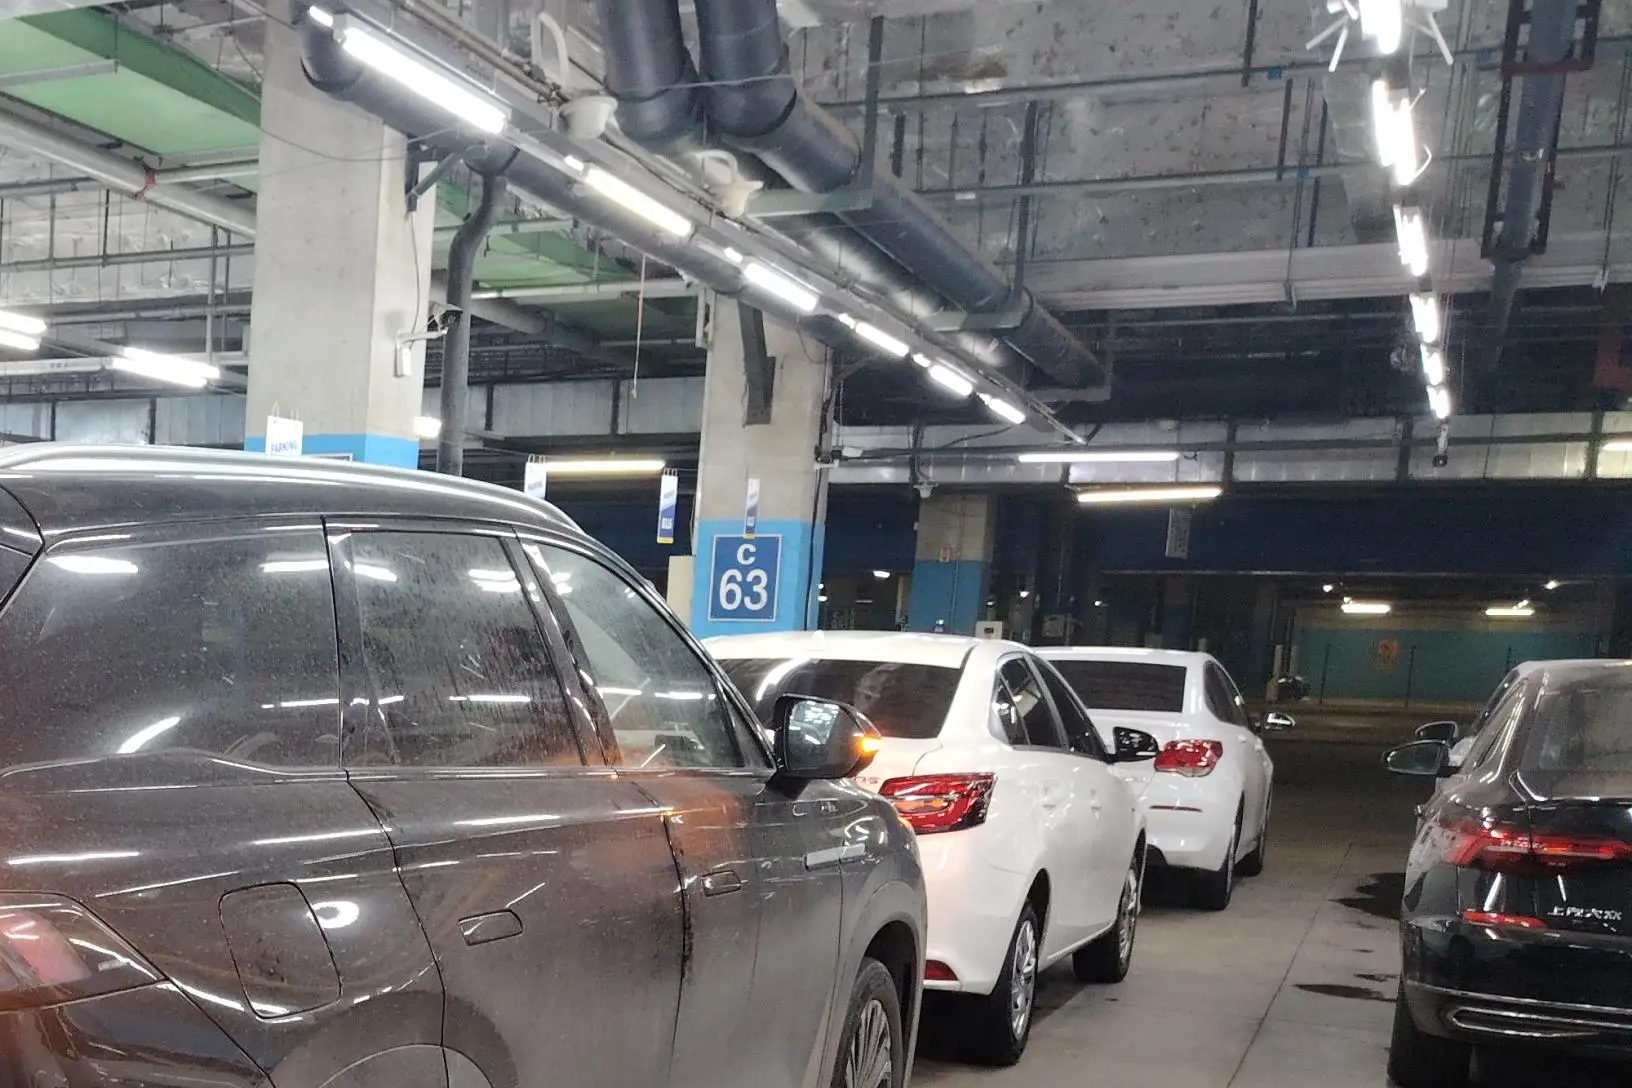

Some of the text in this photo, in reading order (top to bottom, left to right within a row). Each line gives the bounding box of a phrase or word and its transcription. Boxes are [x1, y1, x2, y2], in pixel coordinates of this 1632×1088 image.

[270, 440, 298, 456] PARKING
[736, 543, 757, 566] C
[719, 568, 768, 611] 63
